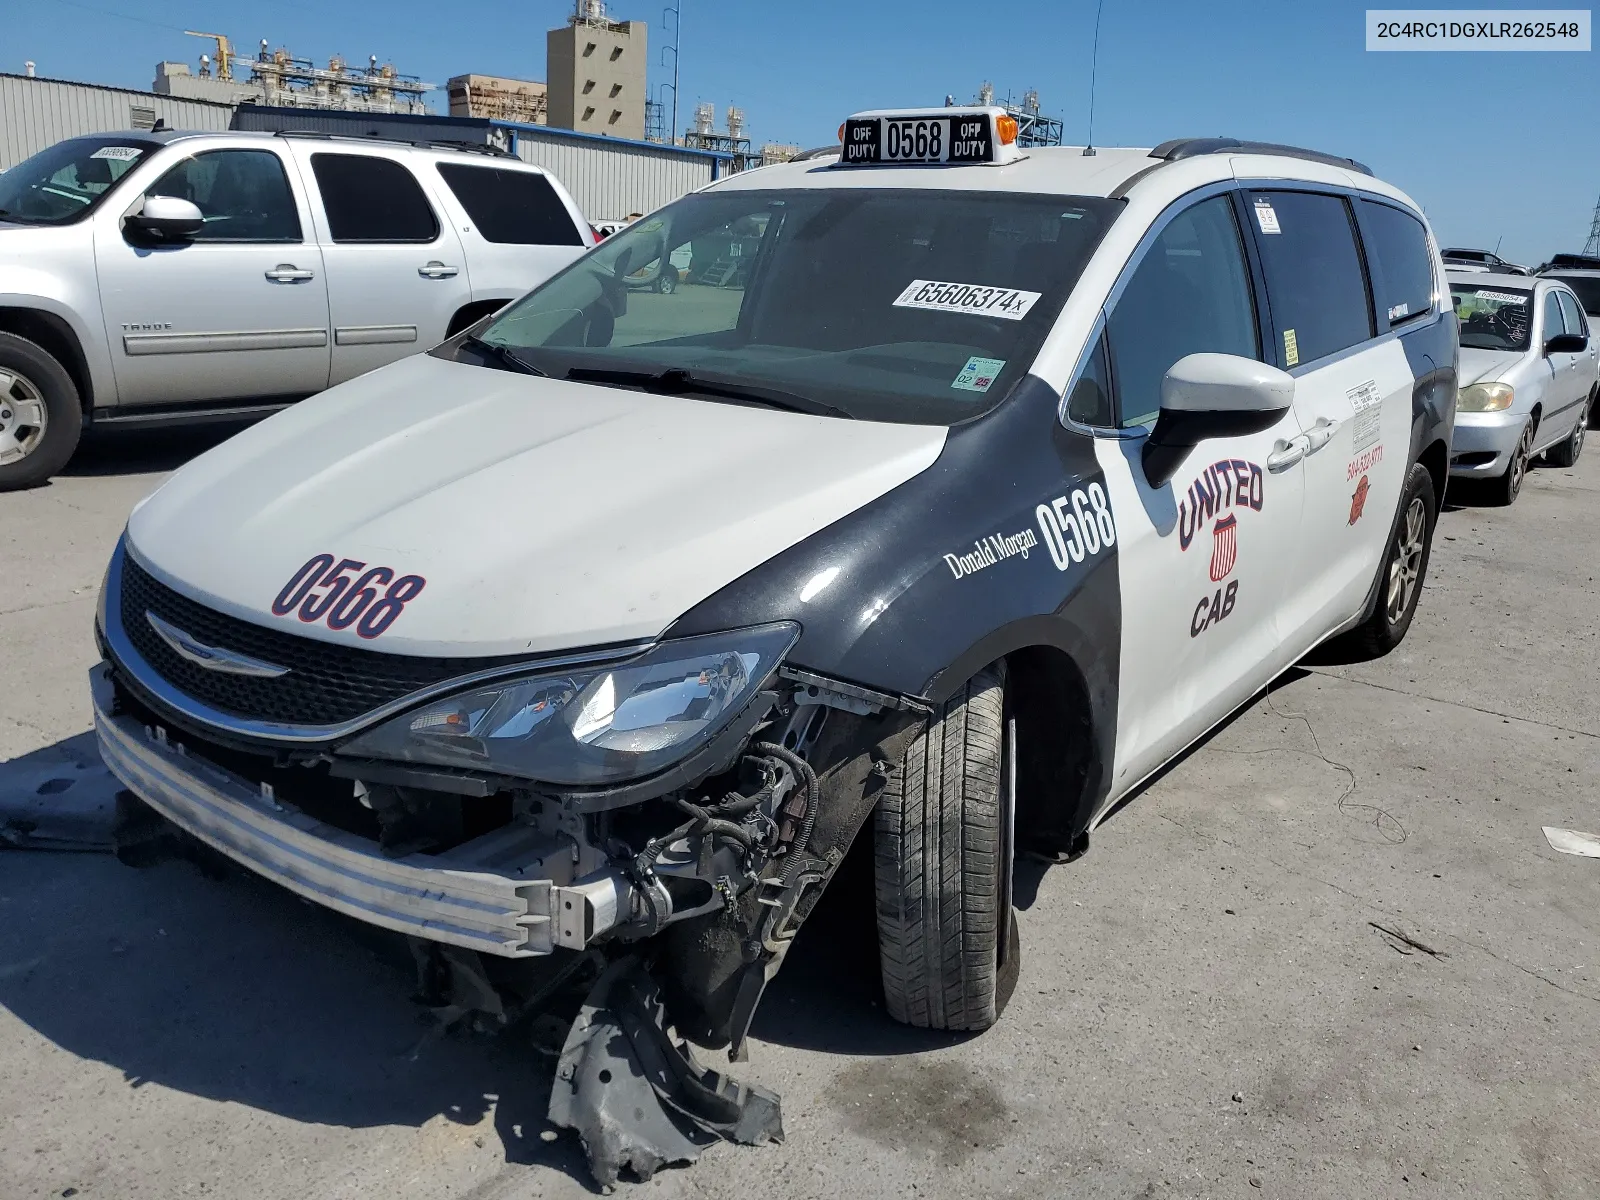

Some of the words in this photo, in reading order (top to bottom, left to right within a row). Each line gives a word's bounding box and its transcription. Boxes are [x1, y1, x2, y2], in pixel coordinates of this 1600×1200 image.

[848, 144, 876, 159] DUTY
[853, 127, 872, 141] OFF
[887, 121, 942, 158] 0568
[954, 140, 986, 157] DUTY
[121, 322, 173, 331] TAHOE
[957, 374, 973, 384] 02
[975, 377, 990, 387] 25
[1179, 458, 1264, 552] UNITED
[1036, 482, 1116, 572] 0568
[943, 538, 998, 580] Donald
[989, 528, 1039, 560] Morgan
[271, 553, 427, 640] 0568
[1190, 579, 1239, 639] CAB
